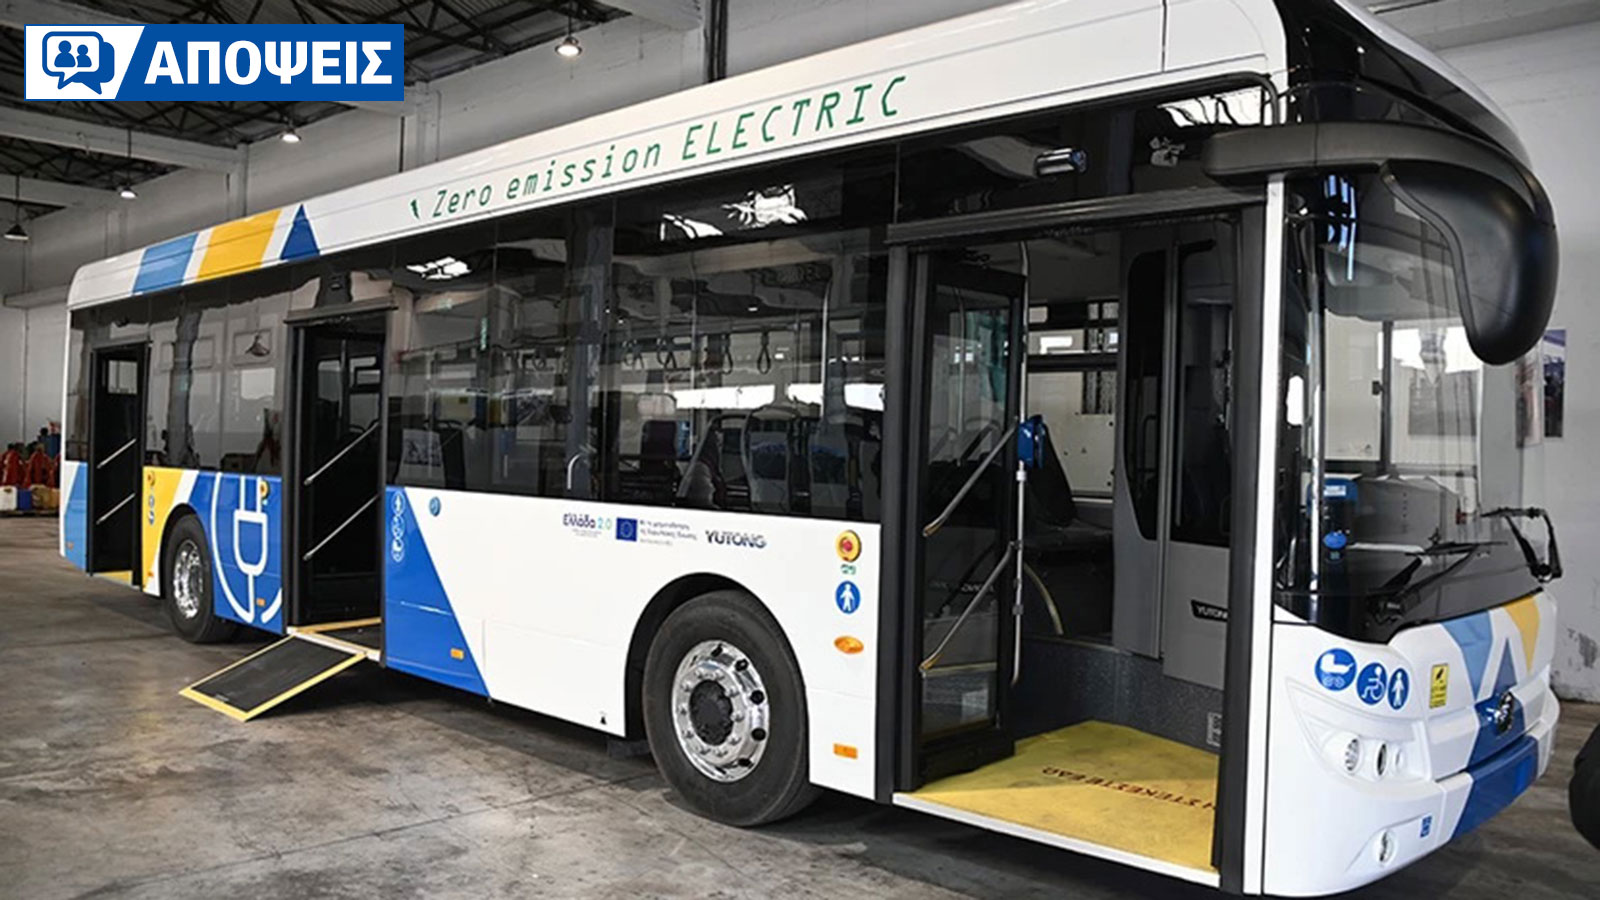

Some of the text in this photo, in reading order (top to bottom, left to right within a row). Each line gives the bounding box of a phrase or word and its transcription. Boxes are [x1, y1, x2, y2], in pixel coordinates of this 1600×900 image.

[432, 76, 906, 218] Zero emission ELECTRIC
[705, 530, 767, 549] YUTONG
